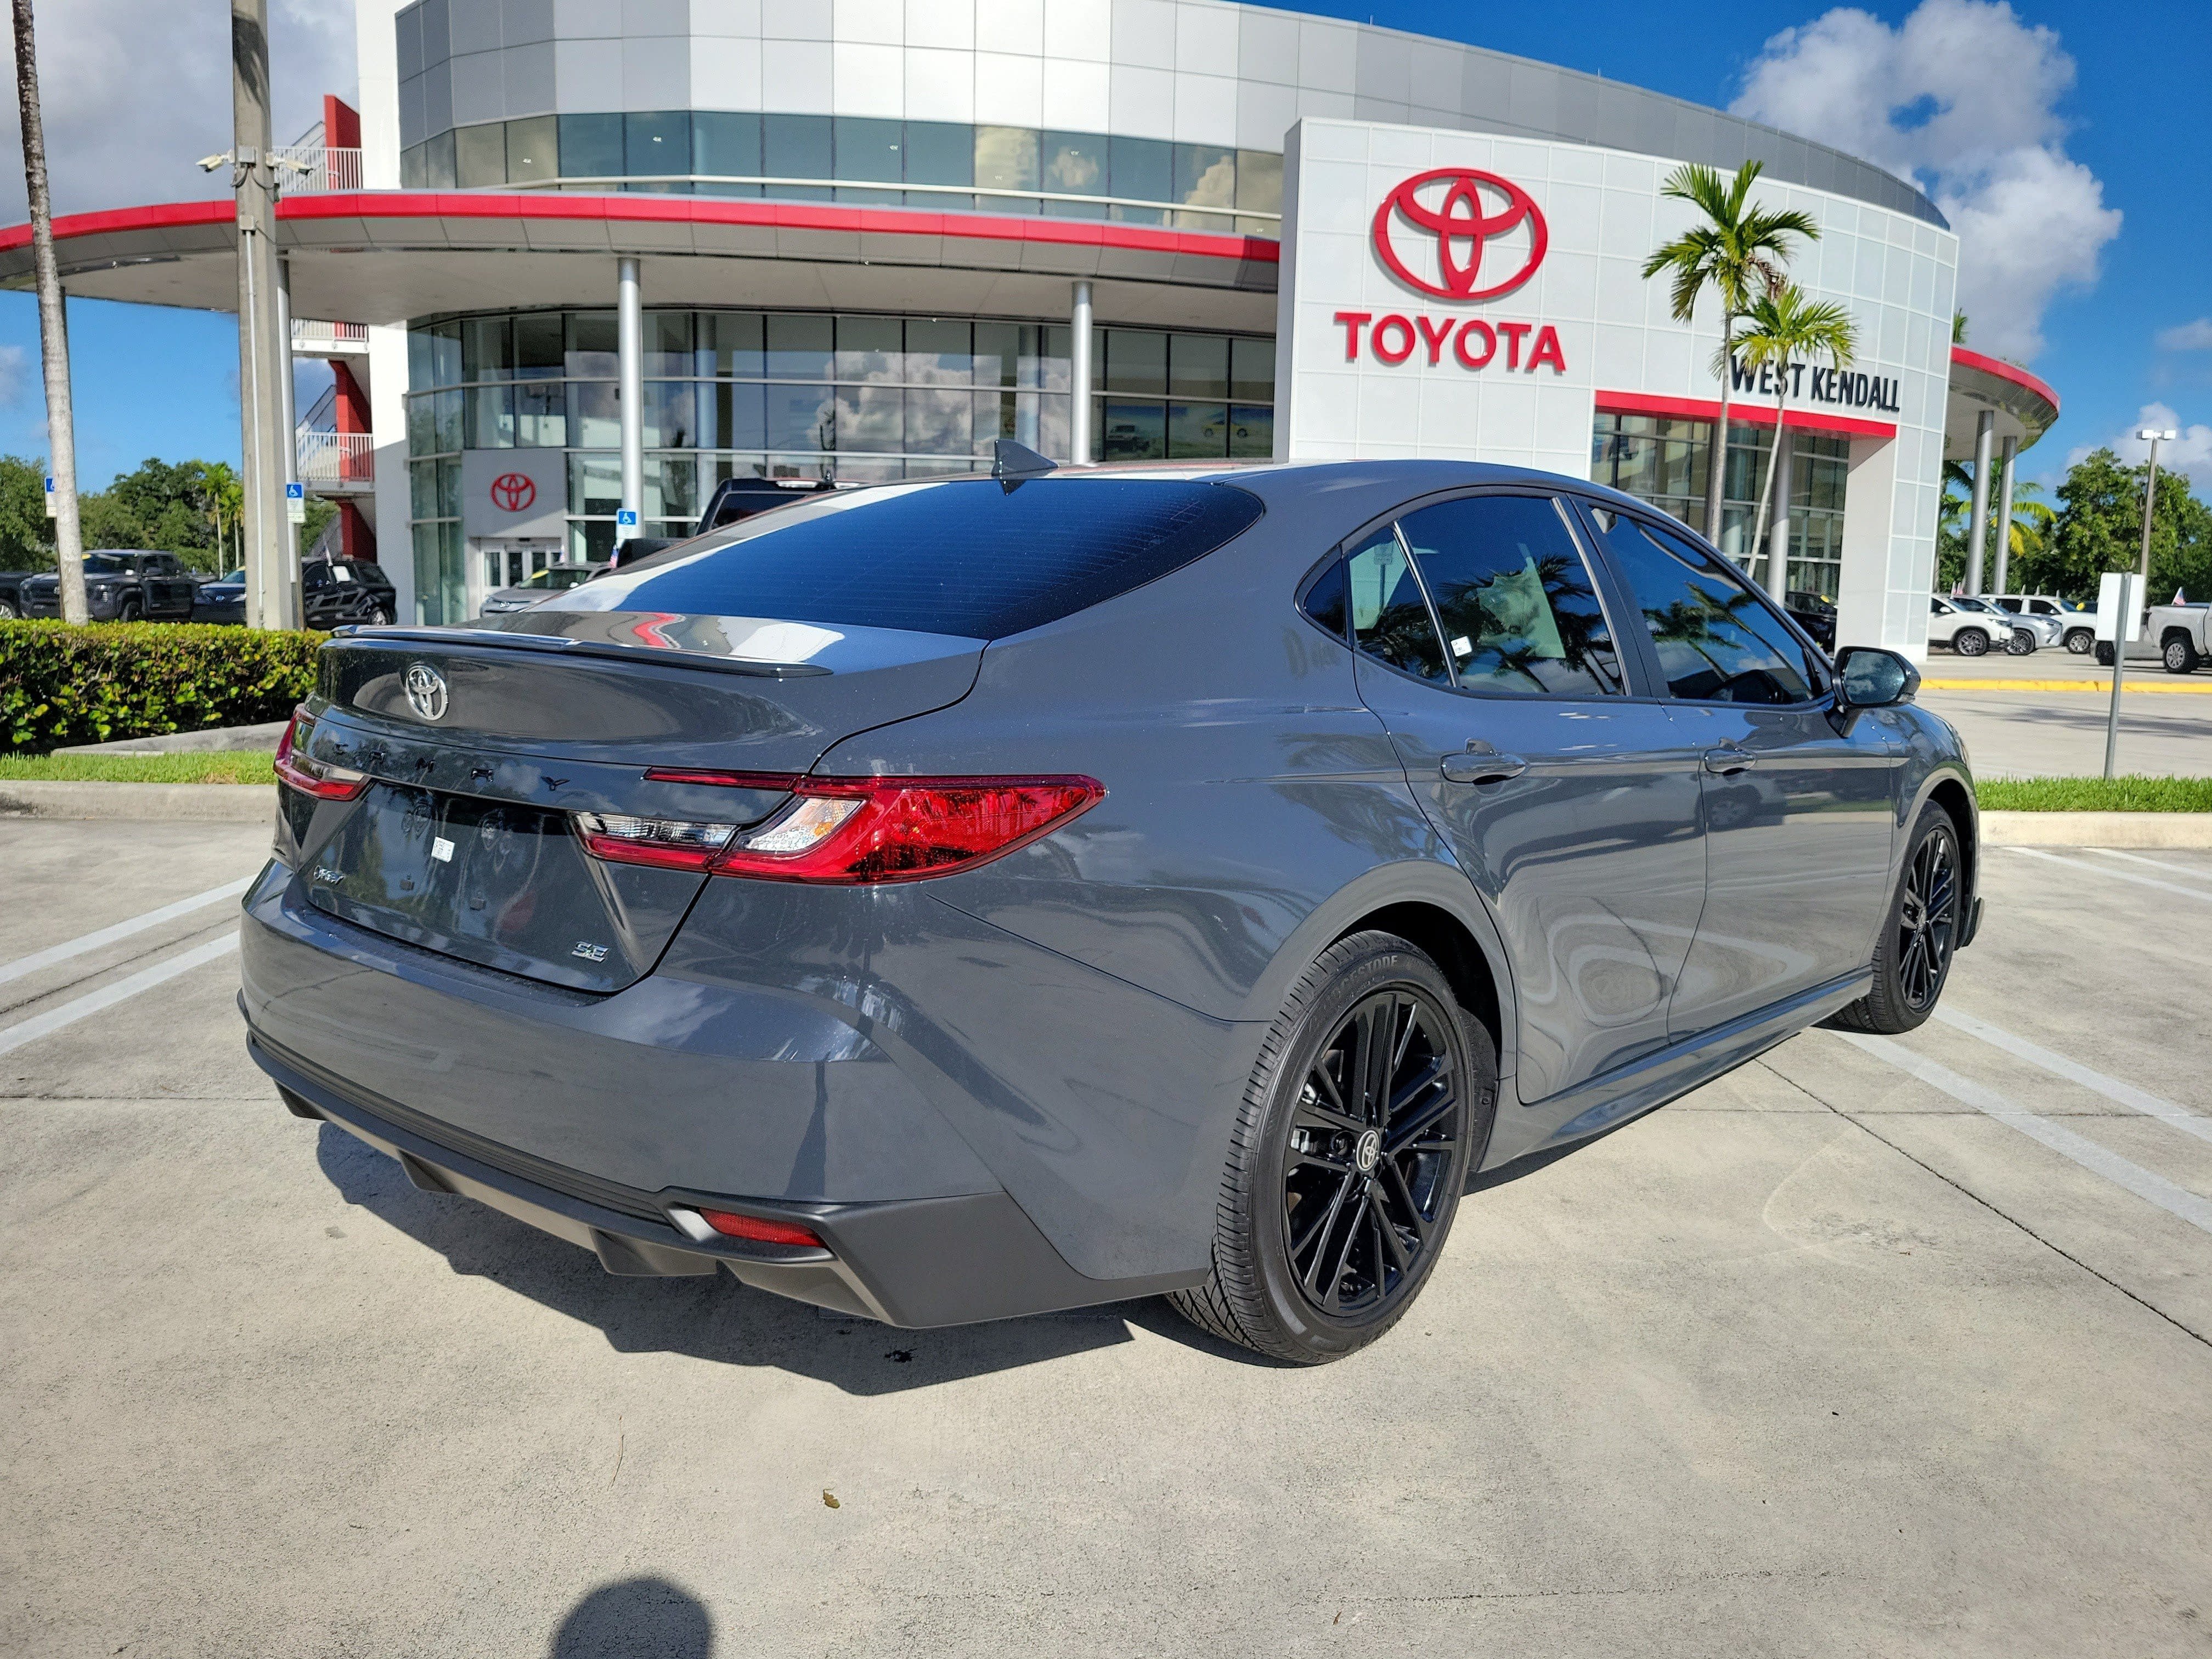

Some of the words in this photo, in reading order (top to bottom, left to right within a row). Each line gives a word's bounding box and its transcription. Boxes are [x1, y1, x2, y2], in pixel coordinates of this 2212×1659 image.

[1335, 312, 1566, 371] TOYOTA
[1811, 366, 1900, 411] KENDALL
[572, 941, 609, 962] SE
